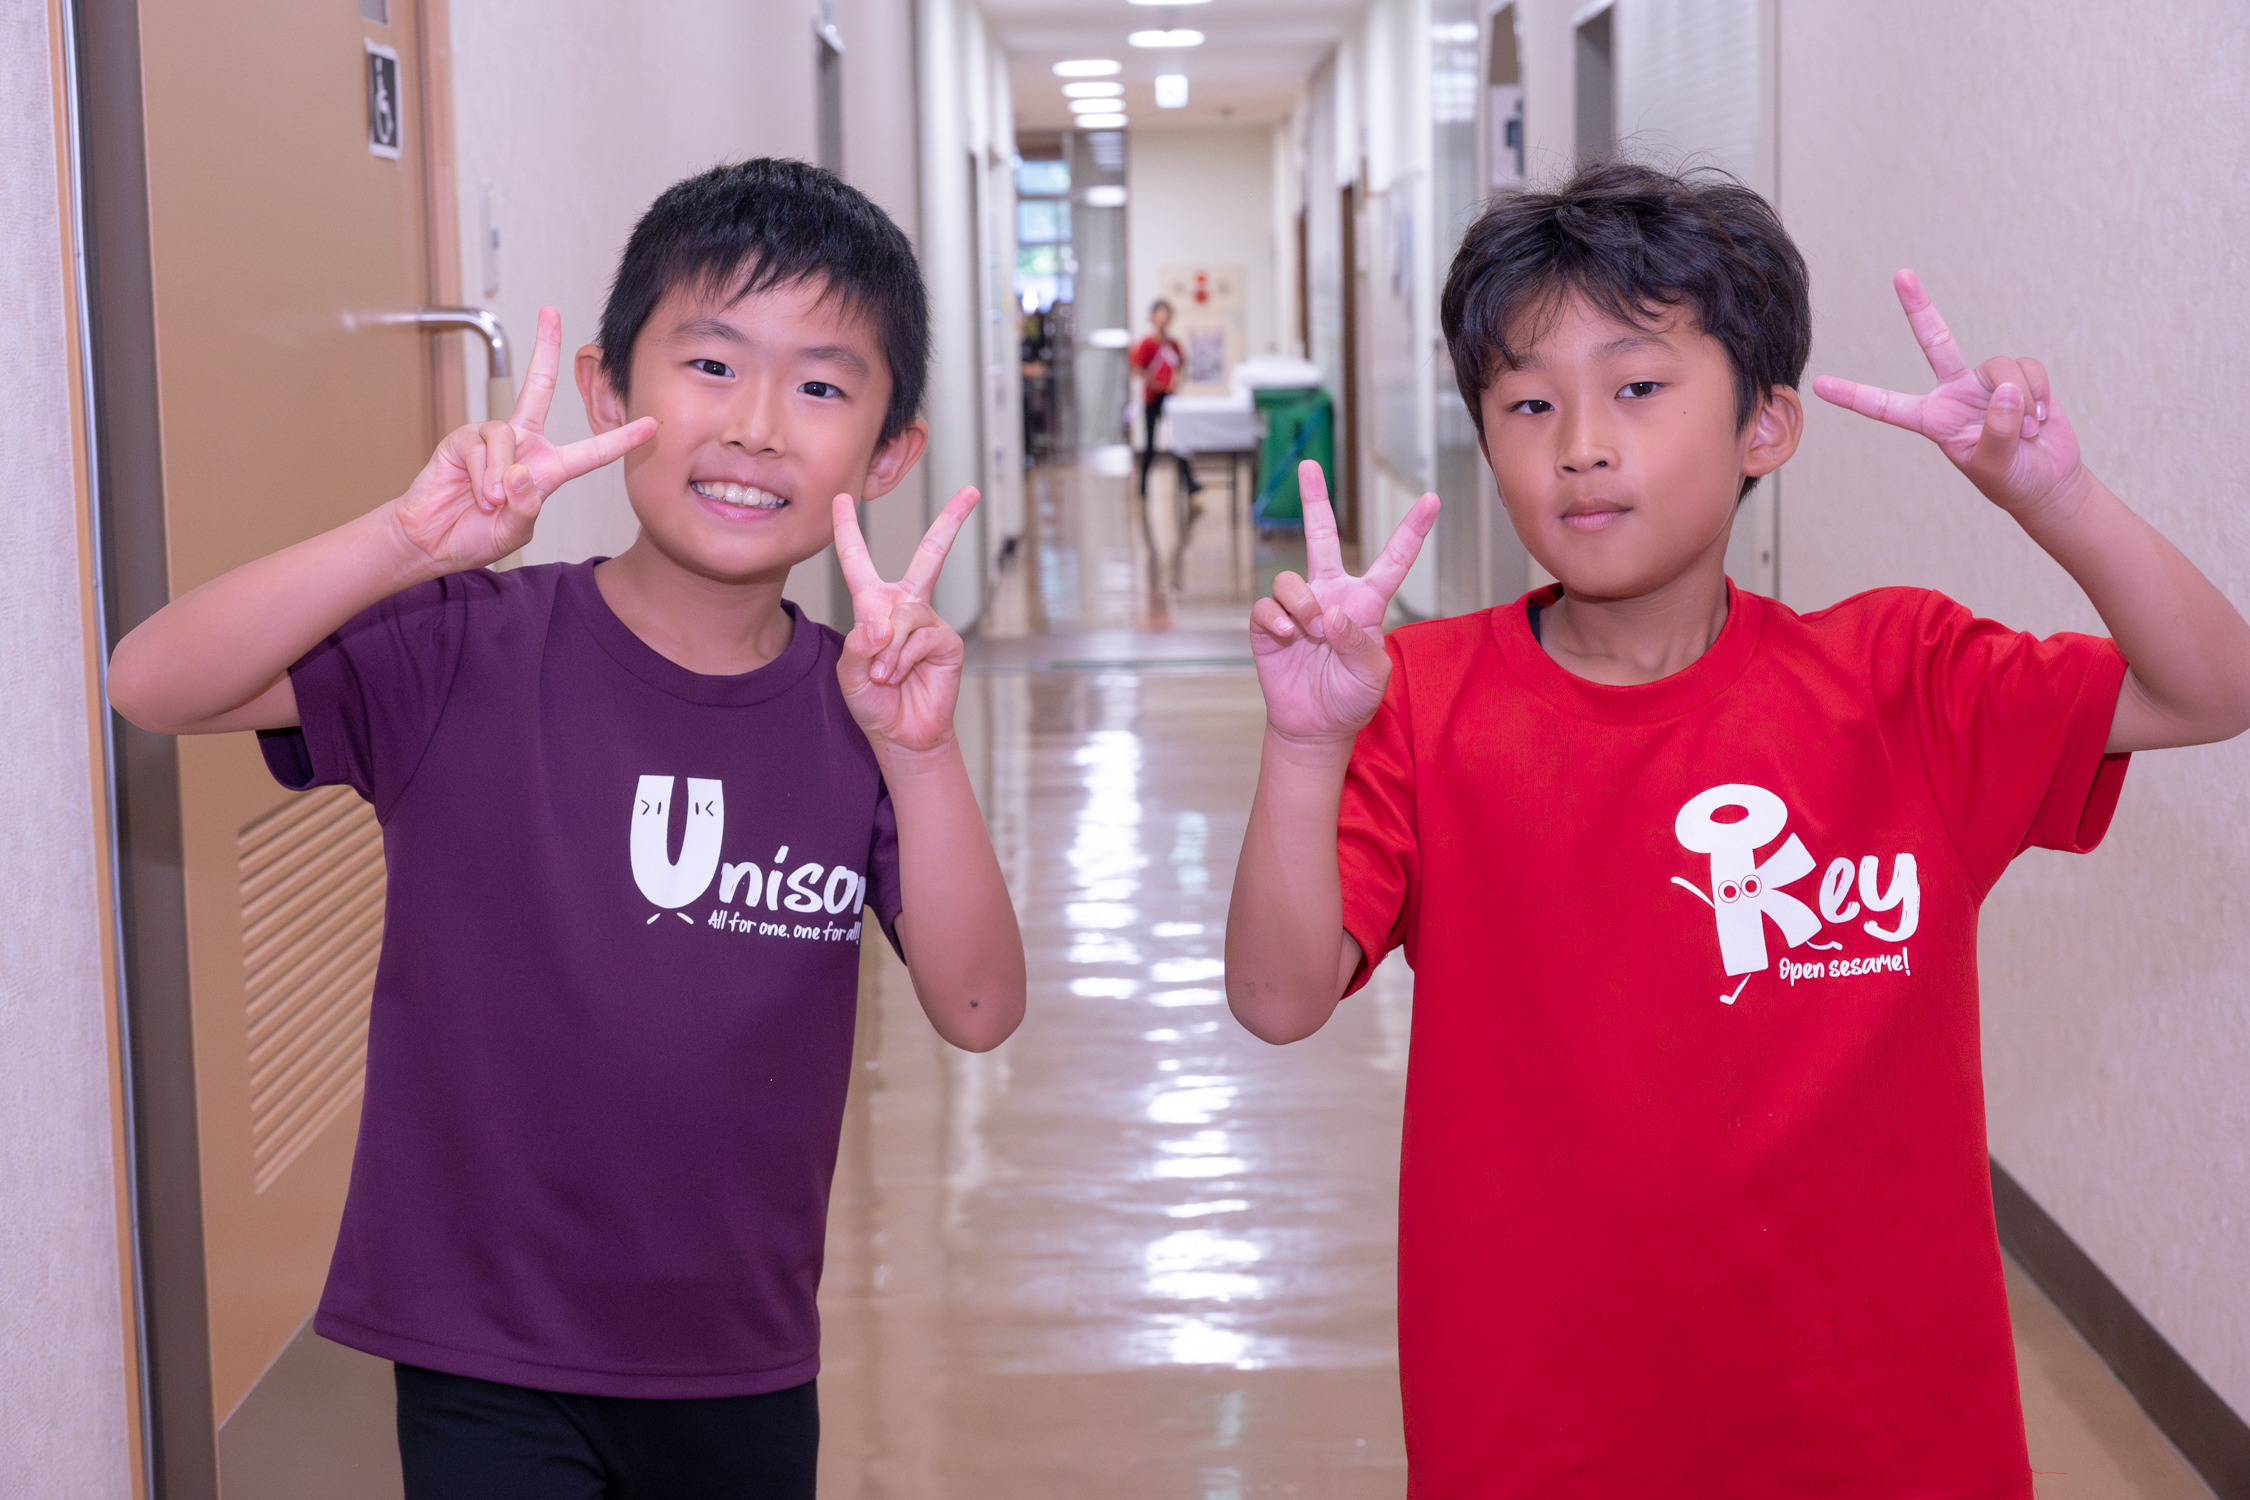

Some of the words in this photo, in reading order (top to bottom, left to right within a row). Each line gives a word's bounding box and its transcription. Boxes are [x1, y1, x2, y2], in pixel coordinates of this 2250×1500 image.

[1675, 783, 1920, 976] Key
[708, 909, 728, 930] All
[728, 911, 757, 933] for
[793, 922, 820, 940] one
[822, 920, 846, 941] for
[1779, 957, 1825, 986] Open
[1828, 946, 1911, 977] sesame!
